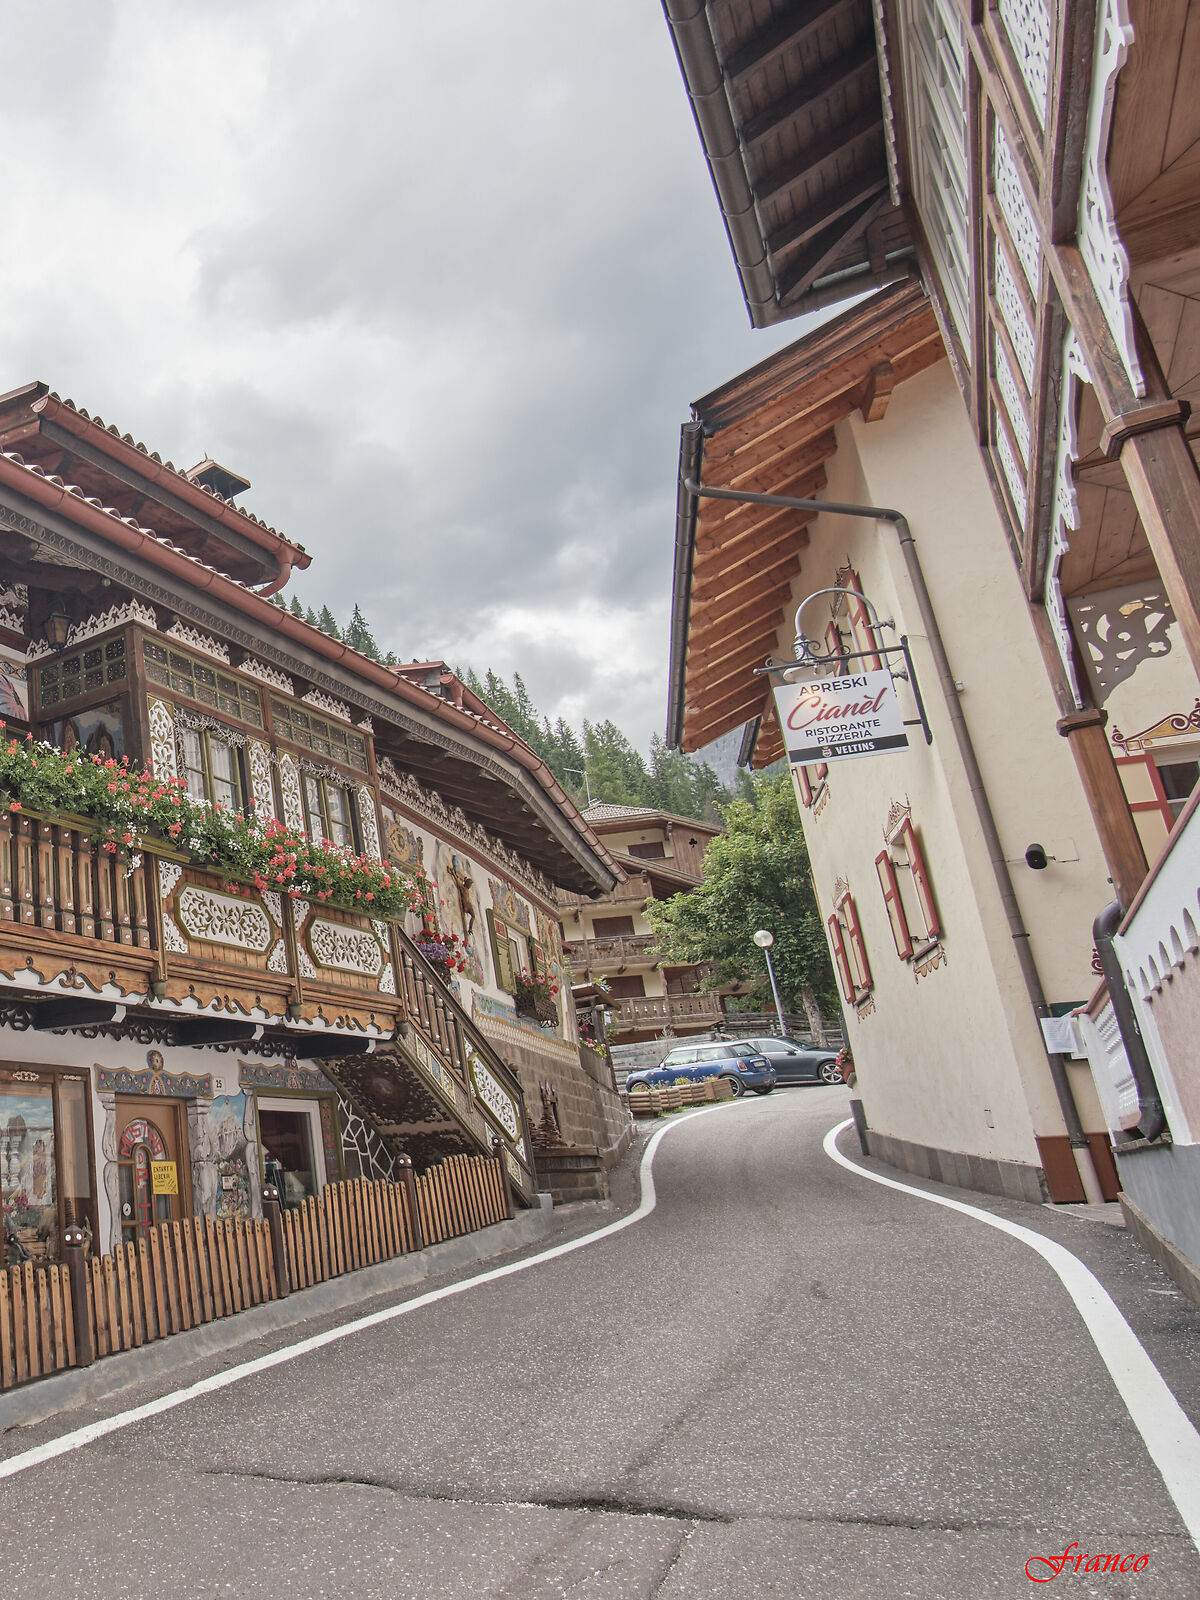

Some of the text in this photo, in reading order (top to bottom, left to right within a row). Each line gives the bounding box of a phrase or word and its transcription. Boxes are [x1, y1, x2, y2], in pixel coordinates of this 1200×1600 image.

[799, 676, 868, 696] APRESKI
[787, 687, 888, 731] Cianèl
[805, 719, 881, 737] RISTORANTE
[817, 729, 873, 745] PIZZERIA
[835, 742, 875, 755] VELTINS
[120, 1121, 164, 1158] MOSTRA
